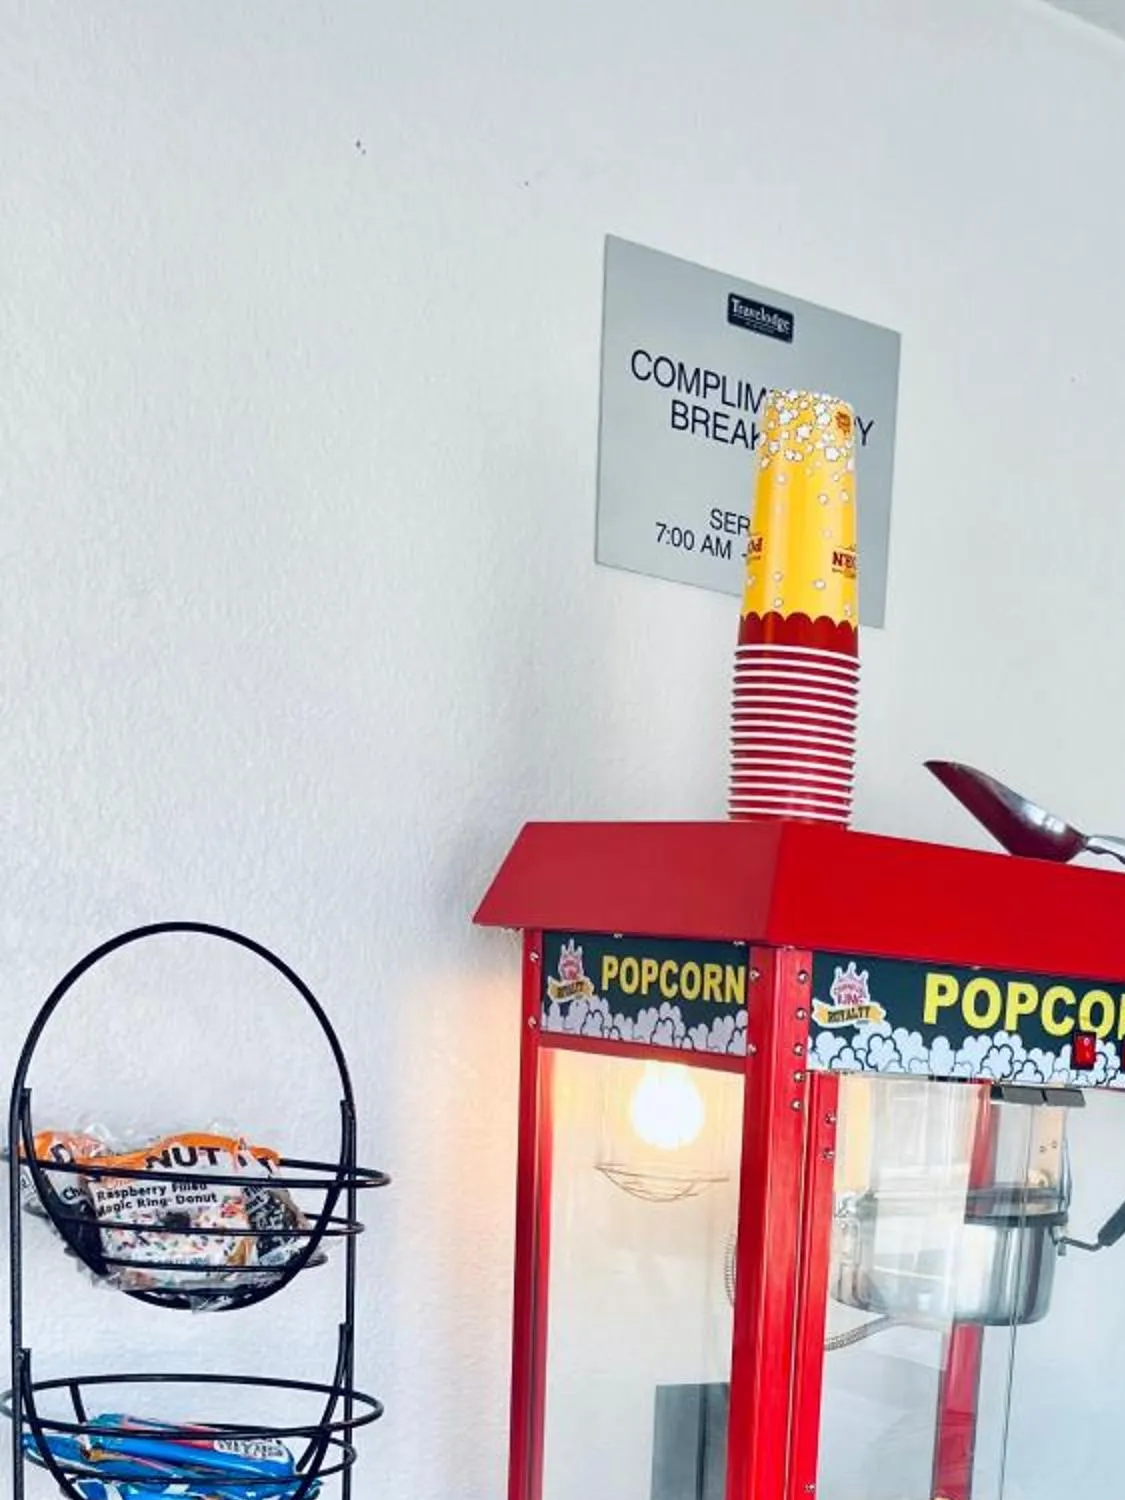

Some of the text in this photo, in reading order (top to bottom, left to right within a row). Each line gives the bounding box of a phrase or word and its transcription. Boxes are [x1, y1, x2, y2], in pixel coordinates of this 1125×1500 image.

[631, 349, 875, 447] COMPLIMY
[671, 399, 761, 450] BREAK
[655, 521, 695, 551] 7:00
[700, 534, 732, 560] AM
[709, 507, 751, 535] SER
[602, 955, 746, 1004] POPCORN
[96, 1184, 167, 1201] Raspberry
[175, 1193, 218, 1206] Donut
